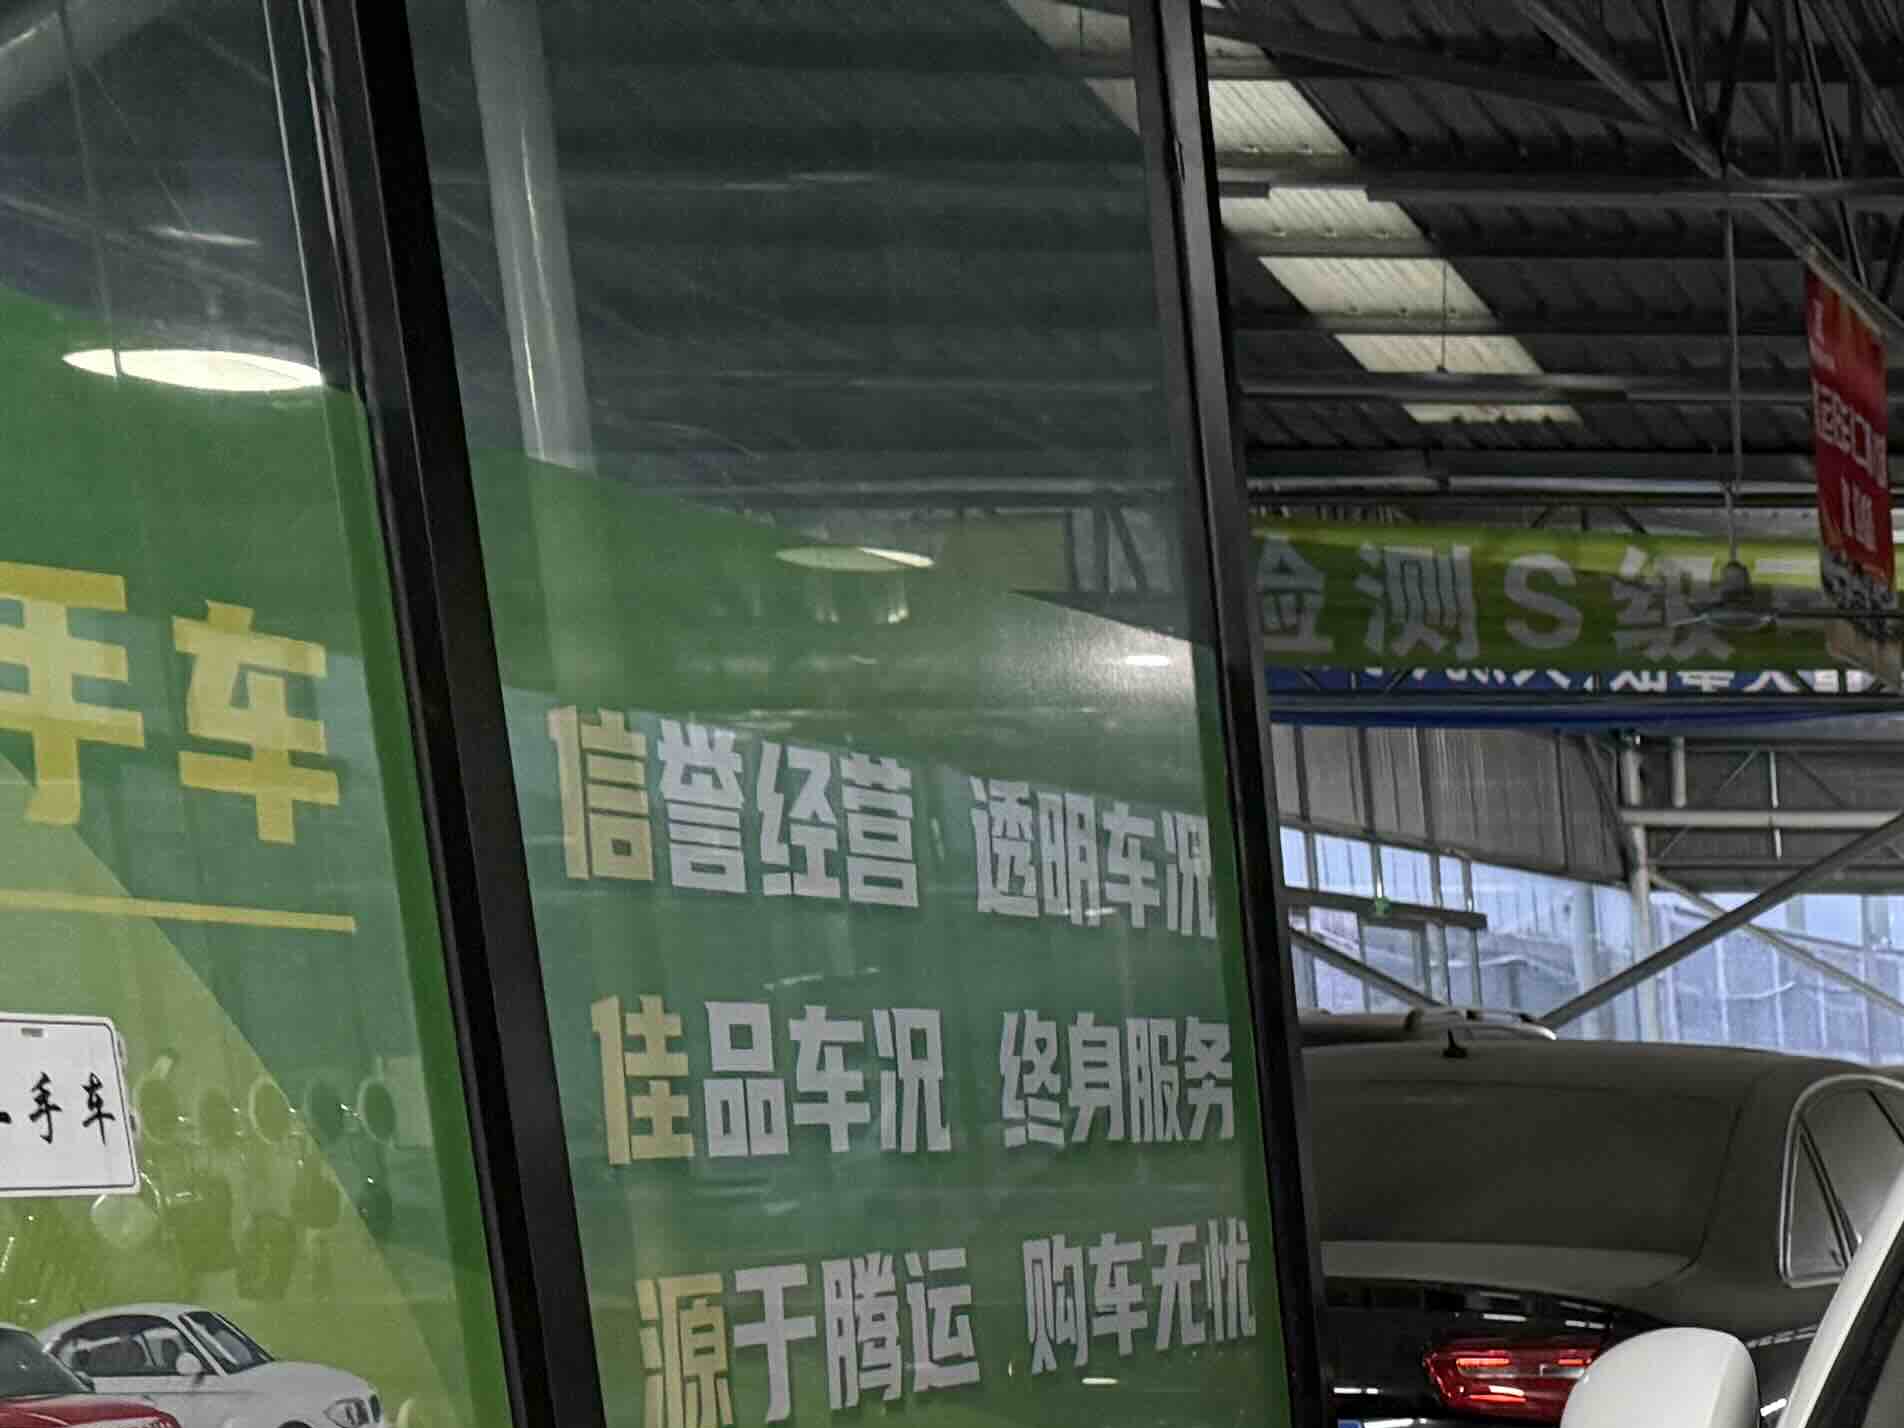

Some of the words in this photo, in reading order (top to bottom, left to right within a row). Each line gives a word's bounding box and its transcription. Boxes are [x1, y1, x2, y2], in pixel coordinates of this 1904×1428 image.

[548, 705, 919, 908] 信誉经营
[969, 776, 1217, 939] 透明车况
[0, 1072, 116, 1146] 手车
[591, 995, 951, 1165] 佳品车况
[1000, 1009, 1234, 1149] 终身服务
[1021, 1217, 1257, 1375] 购车无忧
